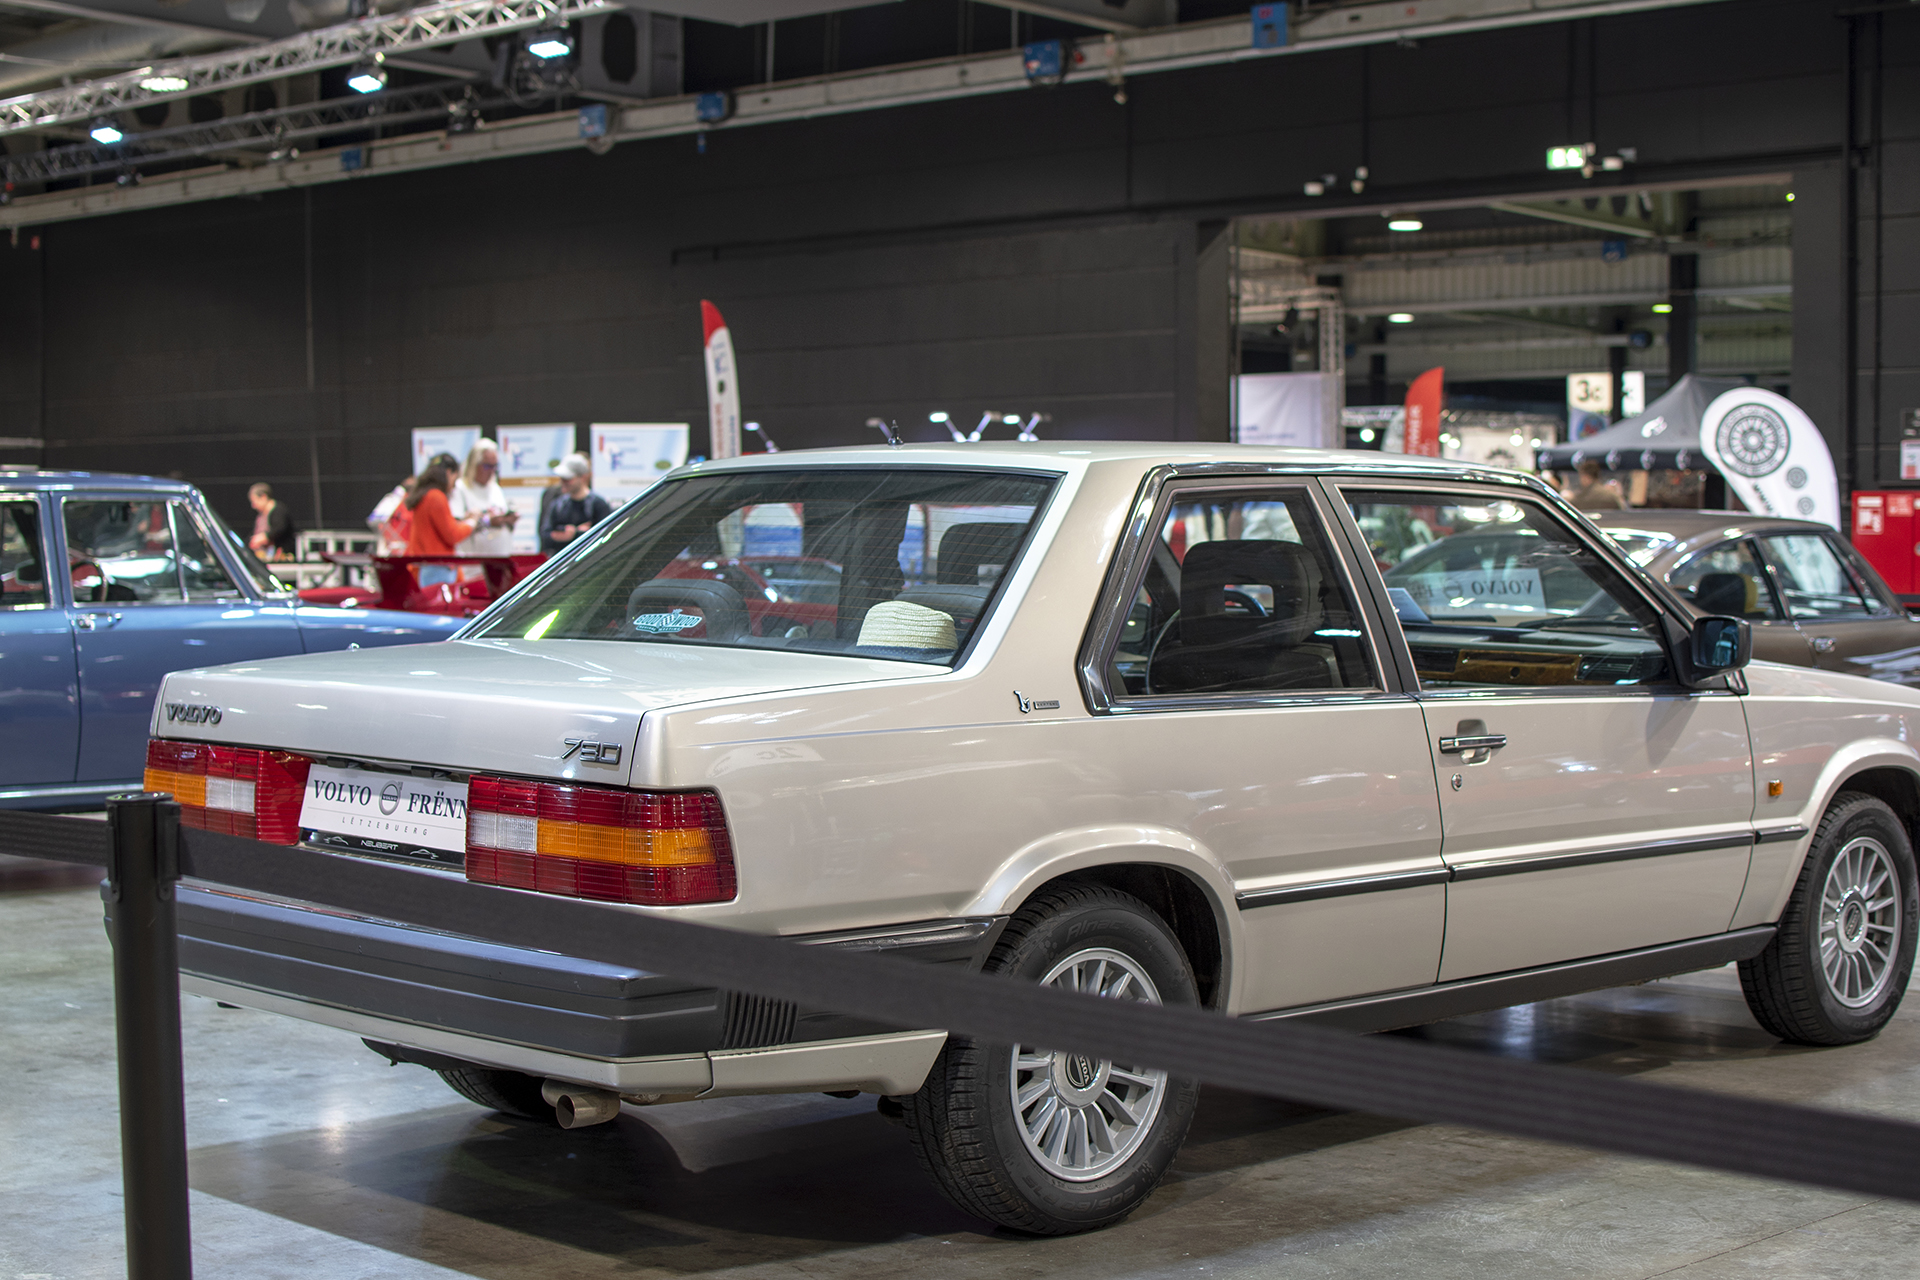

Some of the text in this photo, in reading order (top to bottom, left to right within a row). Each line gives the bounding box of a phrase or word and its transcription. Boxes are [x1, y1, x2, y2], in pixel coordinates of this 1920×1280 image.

[165, 703, 222, 724] VOLVO
[561, 738, 622, 765] 780
[314, 780, 372, 806] VOLVO
